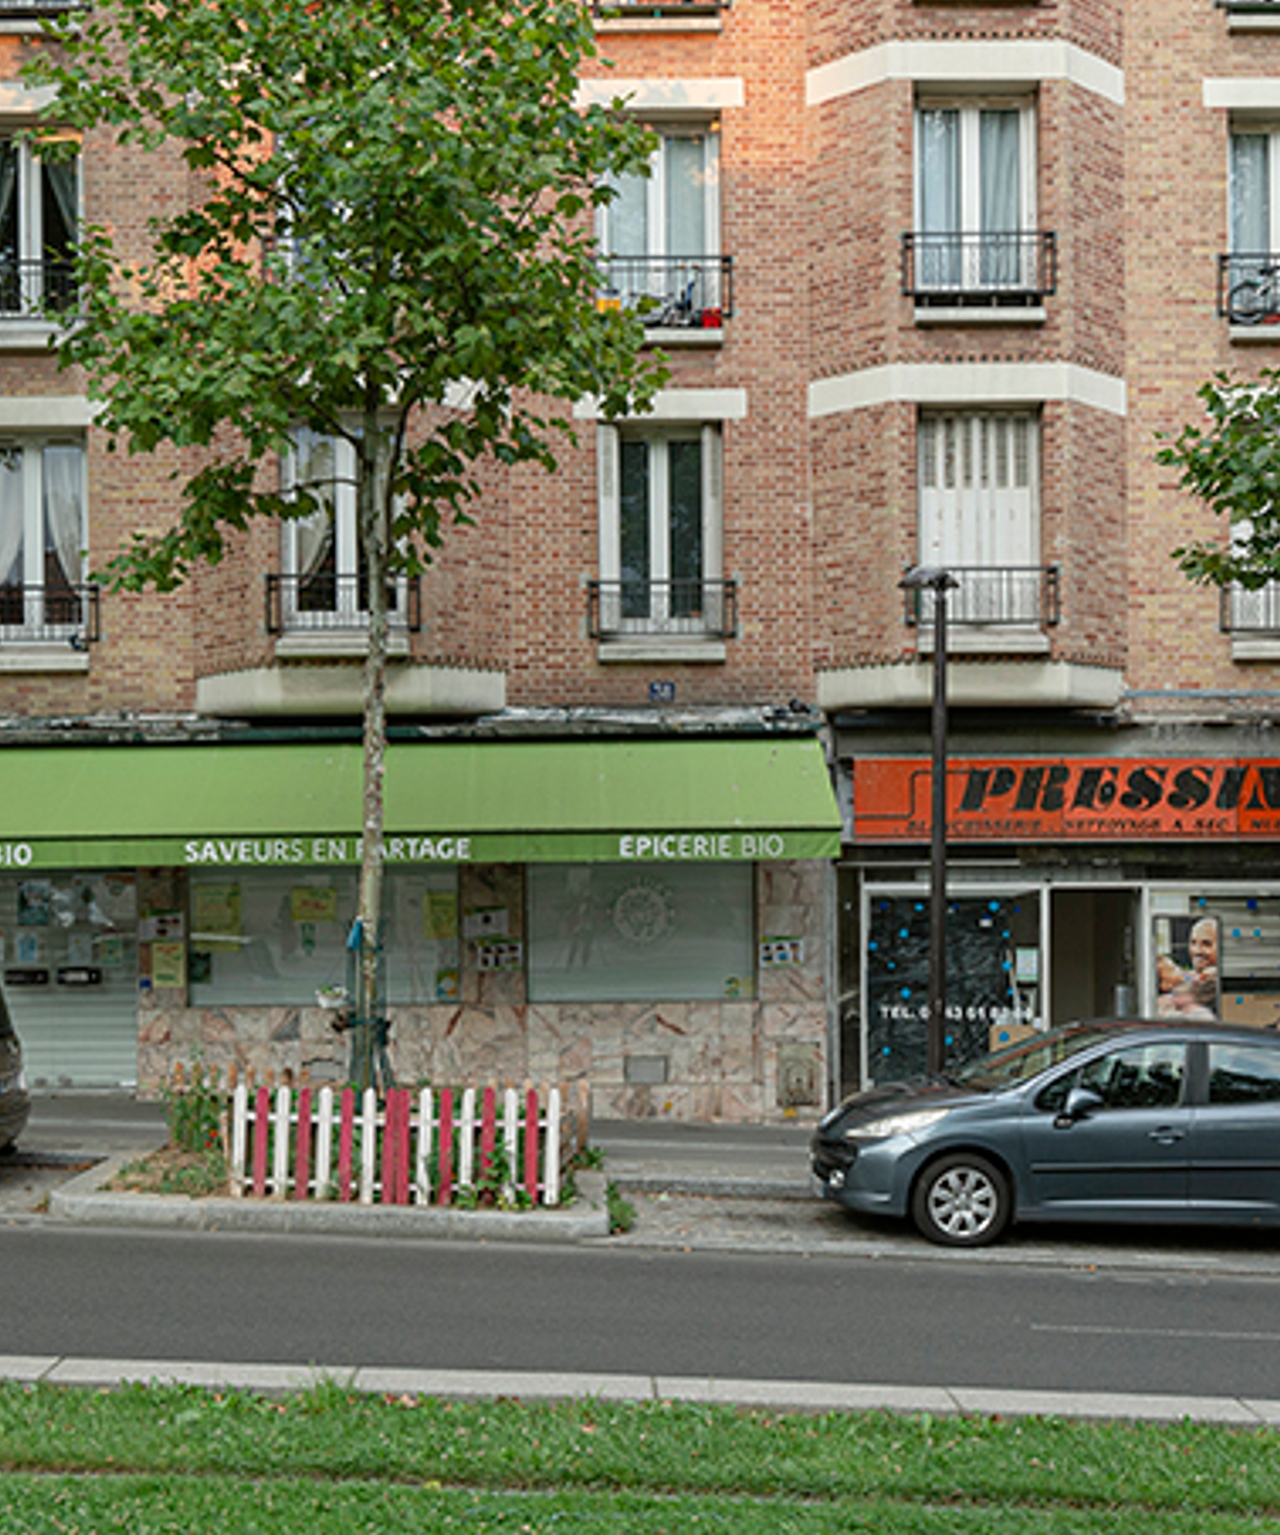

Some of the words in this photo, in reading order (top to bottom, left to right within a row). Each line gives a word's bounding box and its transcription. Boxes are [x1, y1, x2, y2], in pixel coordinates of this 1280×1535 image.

[184, 840, 304, 862] SAVEURS
[312, 839, 346, 861] EN
[619, 834, 732, 857] EPICERIE
[741, 834, 784, 857] BIO
